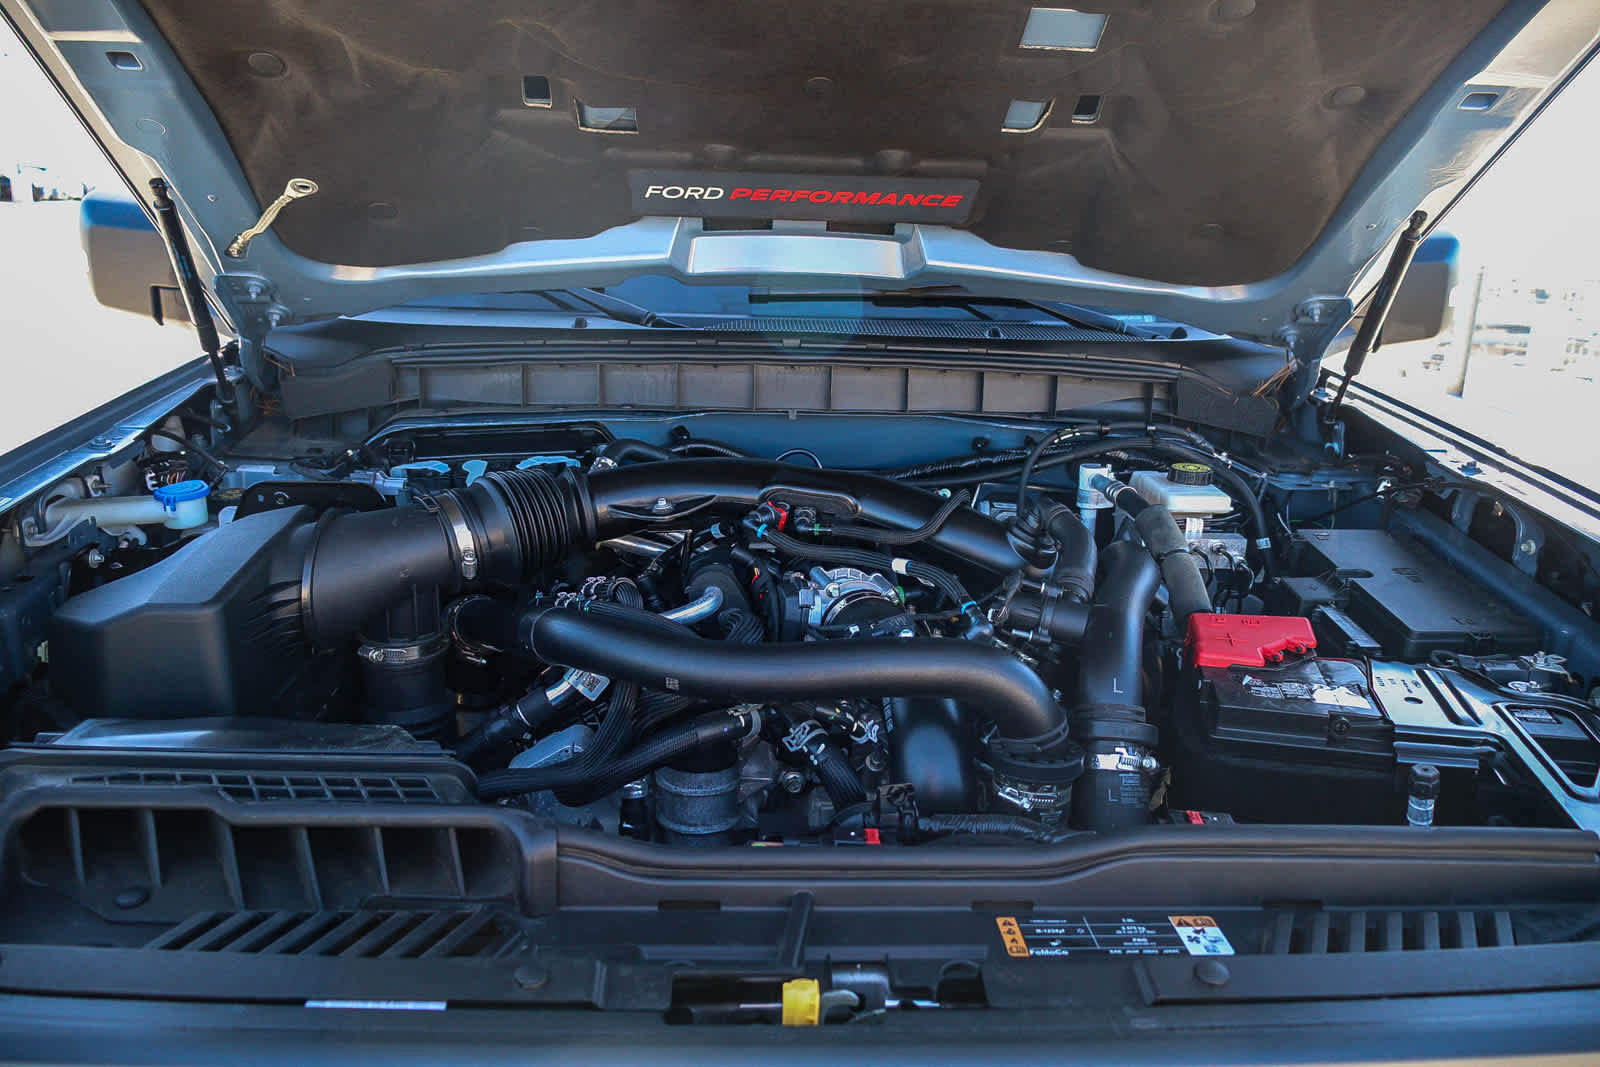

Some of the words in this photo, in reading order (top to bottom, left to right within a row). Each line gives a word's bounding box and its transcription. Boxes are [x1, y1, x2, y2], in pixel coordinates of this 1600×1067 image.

[644, 185, 724, 201] FORD
[729, 187, 963, 208] PERFORMANCE
[1113, 677, 1124, 694] L
